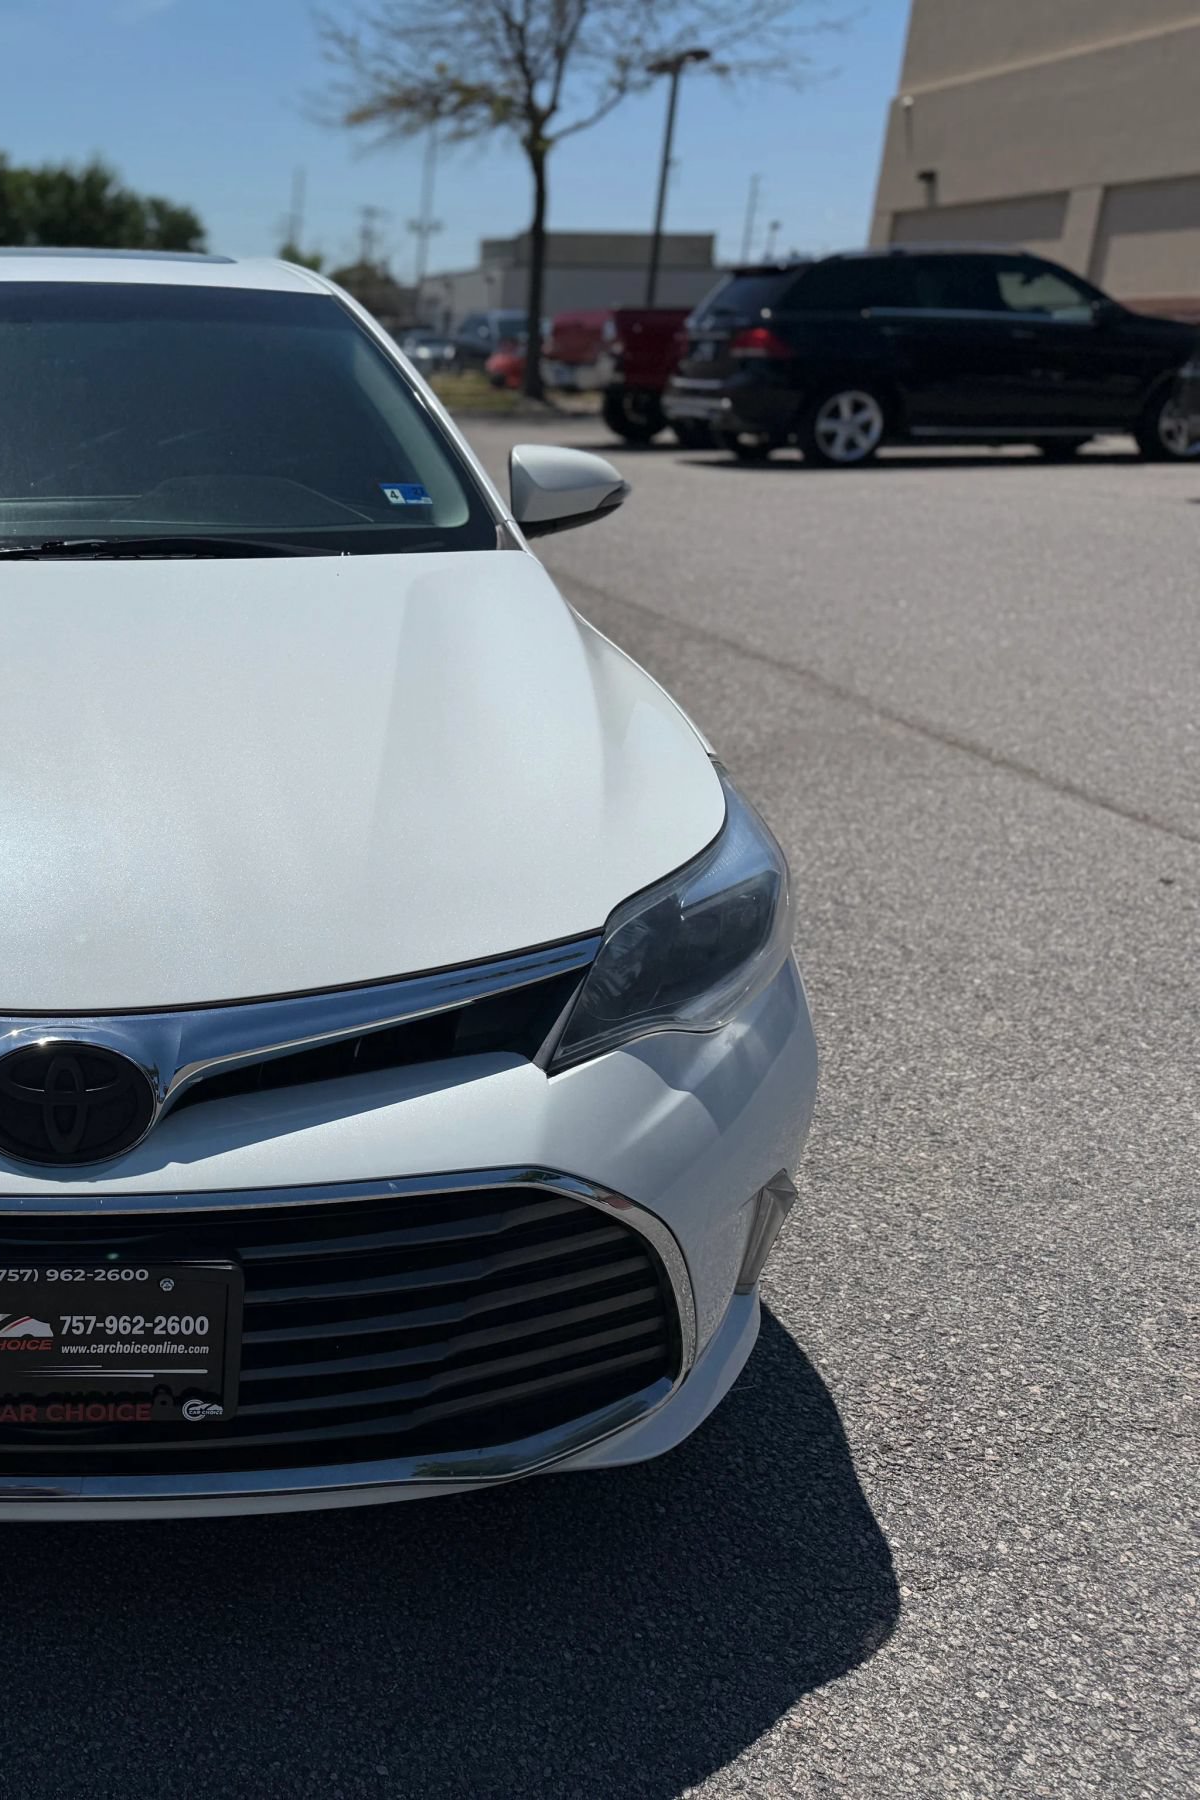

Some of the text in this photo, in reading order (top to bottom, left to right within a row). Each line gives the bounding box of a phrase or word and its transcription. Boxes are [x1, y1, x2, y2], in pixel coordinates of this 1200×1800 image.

[390, 490, 399, 499] 4
[45, 1268, 150, 1282] 962-2600
[59, 1315, 210, 1335] 757-962-2600
[61, 1341, 210, 1354] www.carchoiceonline.com
[46, 1403, 153, 1422] CHOICE
